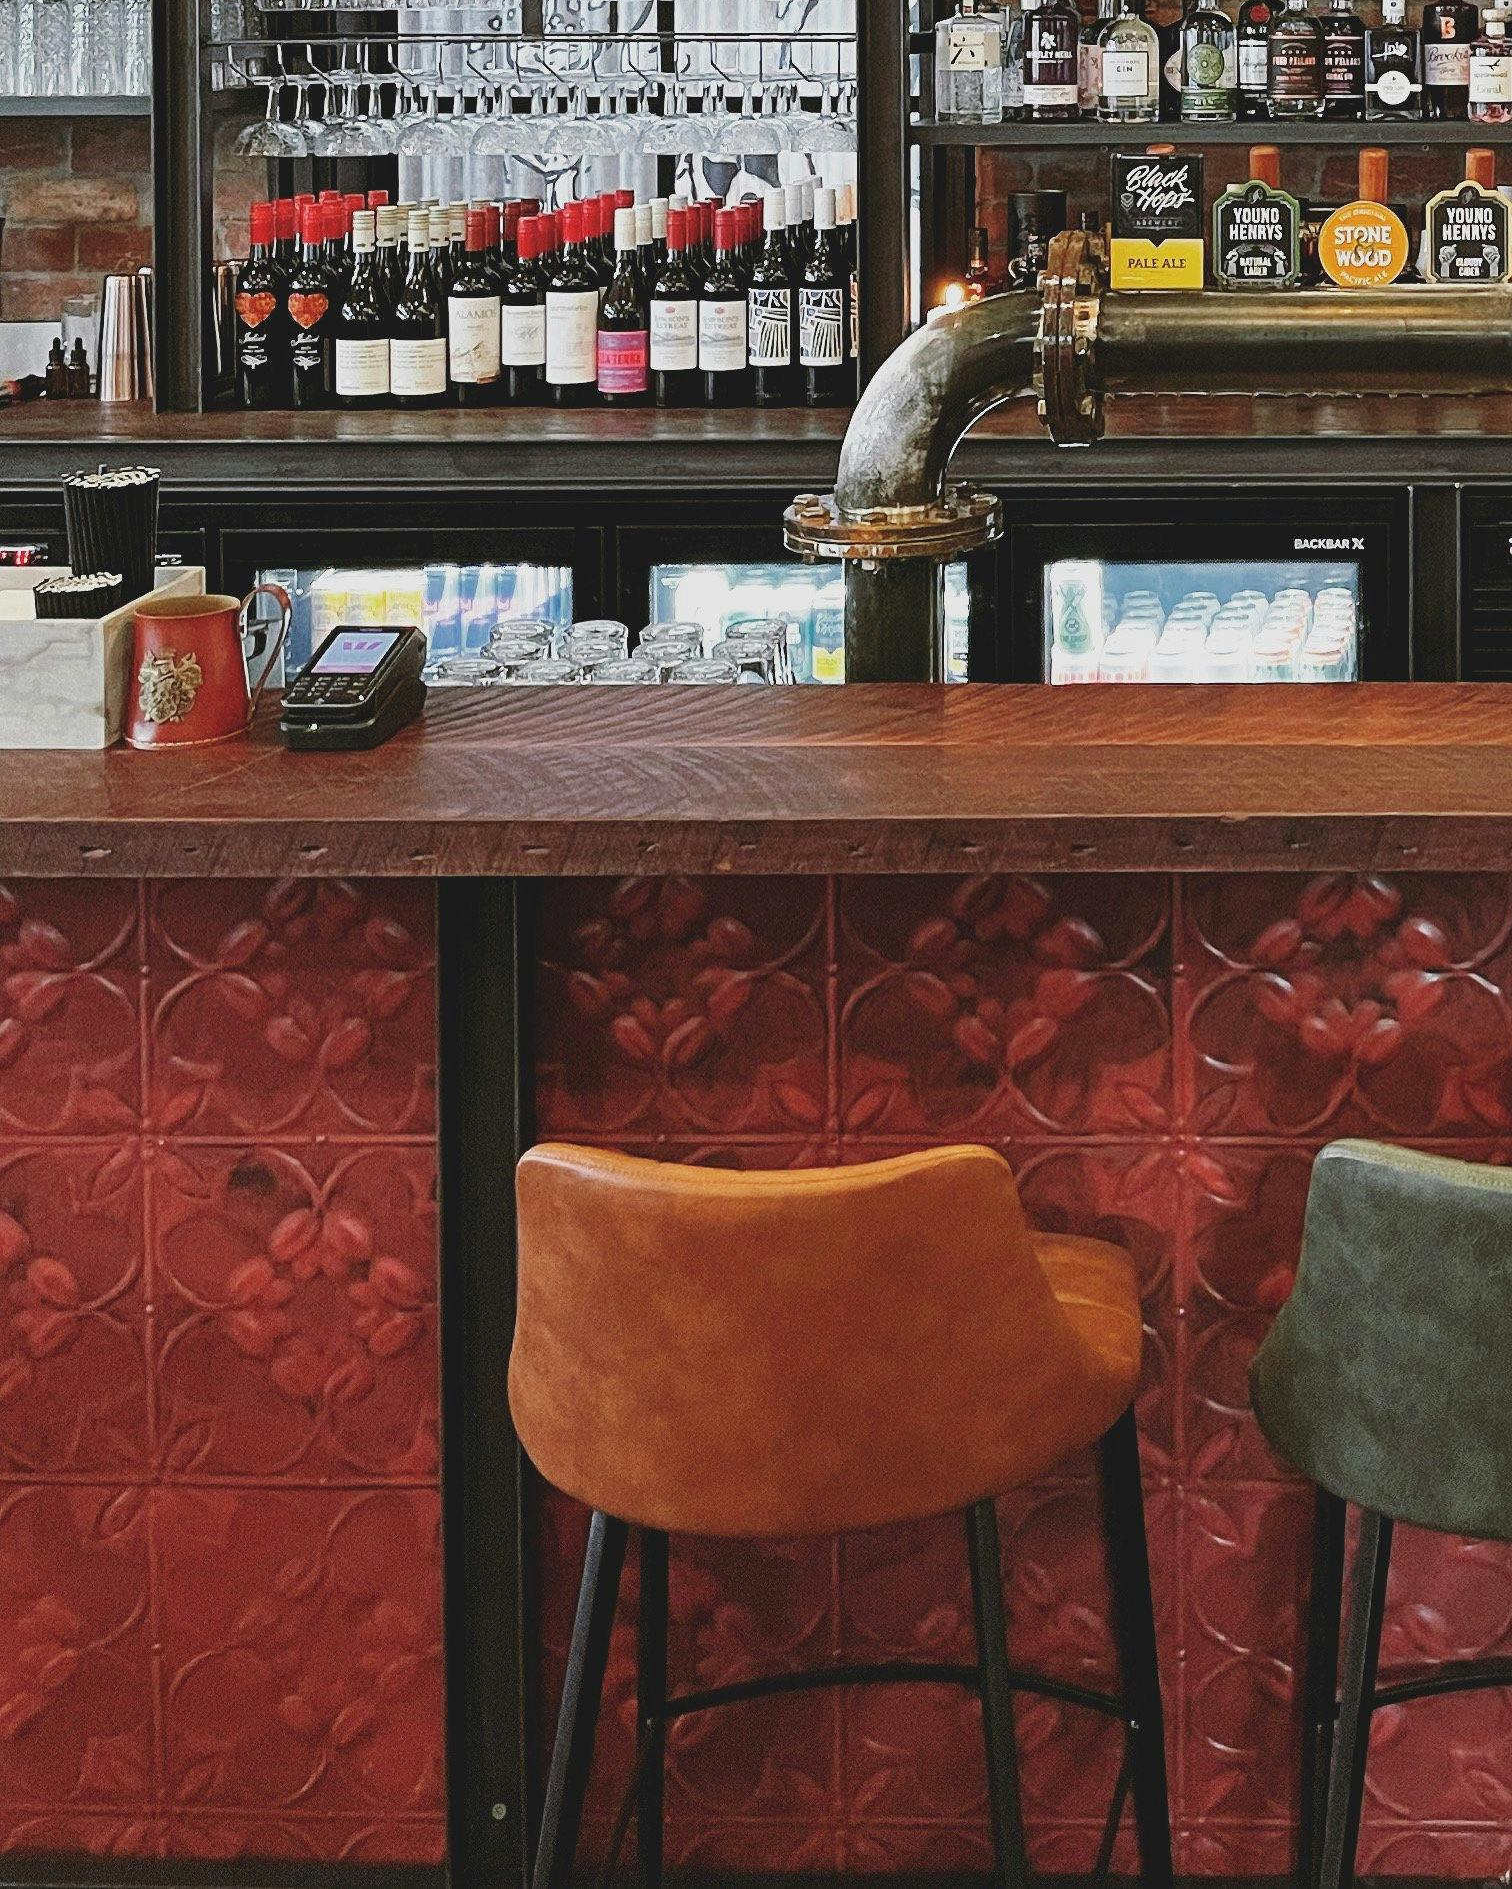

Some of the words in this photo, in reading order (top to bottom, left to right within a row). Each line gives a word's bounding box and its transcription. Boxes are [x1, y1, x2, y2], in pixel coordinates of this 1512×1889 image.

[1440, 16, 1456, 39] B
[951, 36, 985, 65] 六
[1126, 165, 1189, 192] Black
[1136, 186, 1195, 216] Hops
[1233, 207, 1280, 224] YOUNG
[1446, 207, 1493, 224] YOUNG
[1229, 224, 1283, 241] HENRYS
[1334, 225, 1392, 245] STONE
[1442, 224, 1497, 241] HENRYS
[1127, 258, 1160, 269] PALE
[1161, 258, 1187, 269] ALE
[1334, 249, 1392, 267] WOOD
[1339, 271, 1372, 286] PACIFIC
[1374, 270, 1389, 283] ALE
[455, 309, 496, 318] ALAMOS
[1294, 538, 1350, 549] BACKBAR
